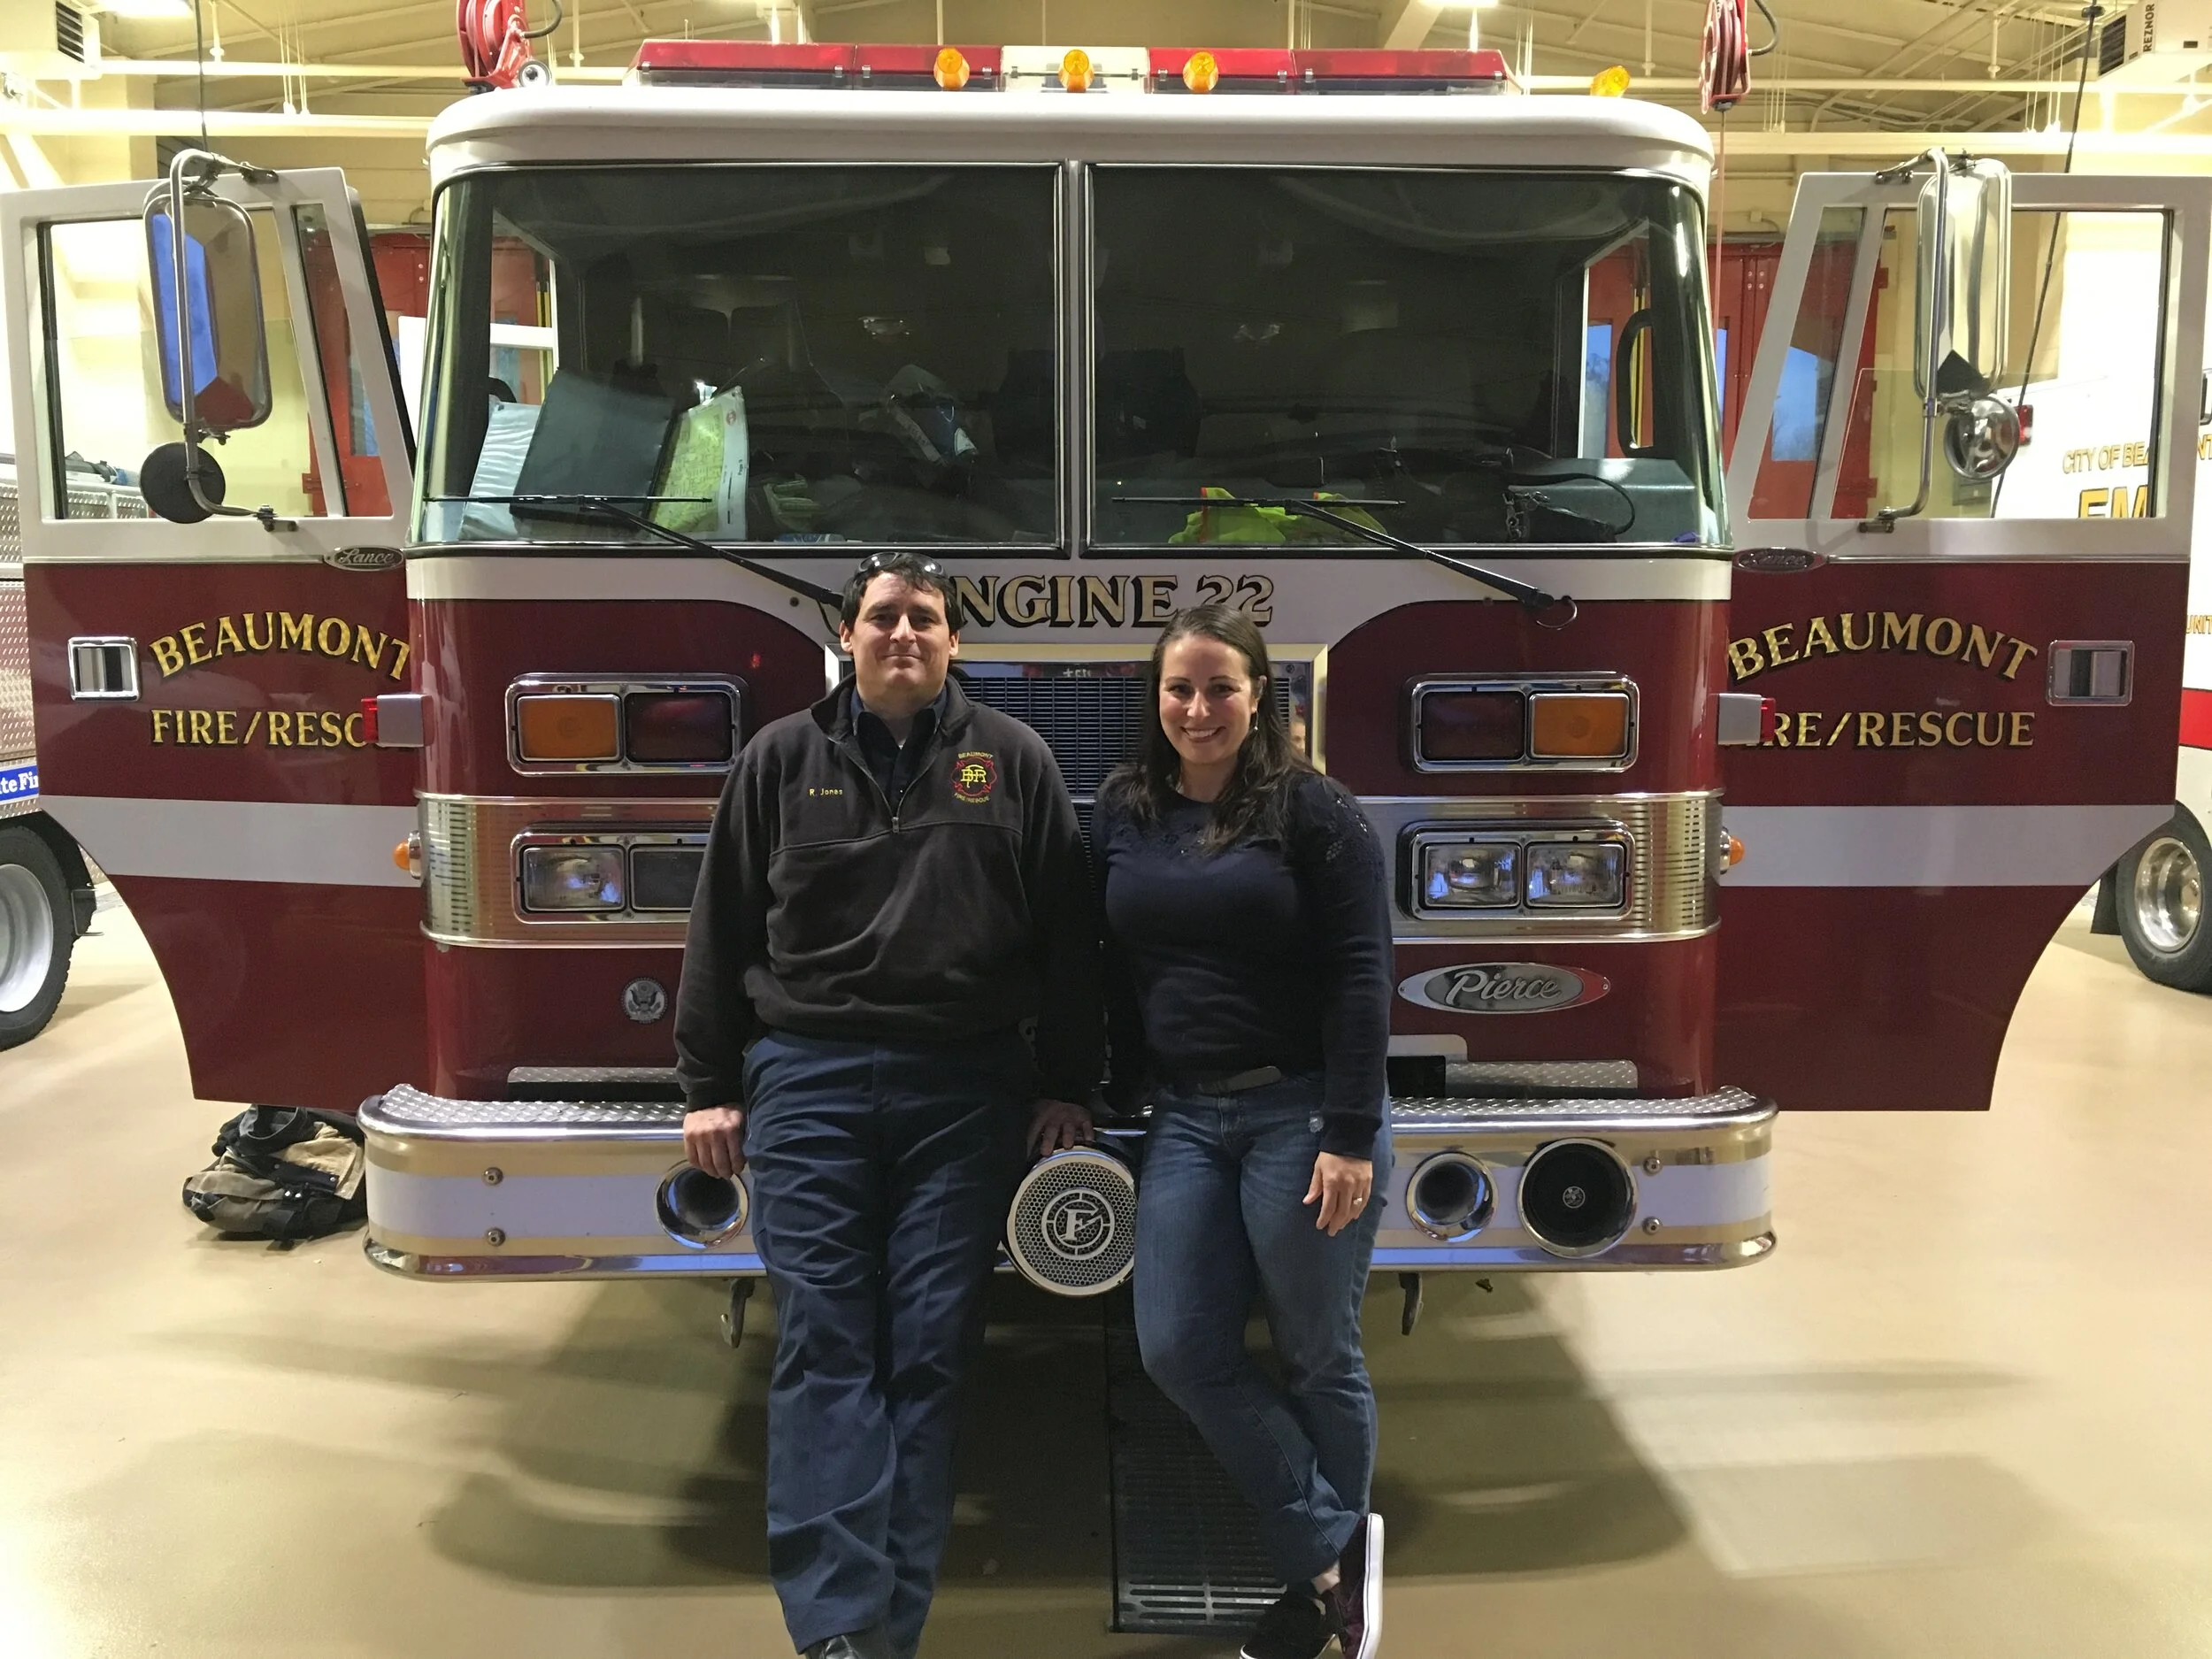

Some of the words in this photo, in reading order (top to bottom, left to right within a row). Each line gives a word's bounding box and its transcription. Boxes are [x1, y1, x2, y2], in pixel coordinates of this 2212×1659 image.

[2143, 4, 2155, 52] REZNOR
[2062, 448, 2096, 474] CITY
[2098, 444, 2121, 471] OF
[338, 549, 395, 566] Lance
[950, 574, 1179, 627] NGINE
[1195, 574, 1274, 627] 22
[149, 611, 411, 681] BEAUMONT
[1727, 611, 2039, 681] BEAUMONT
[150, 709, 368, 748] FIRE/RESC
[1761, 710, 2036, 748] RE/RESCUE
[1445, 970, 1562, 1006] Pierce
